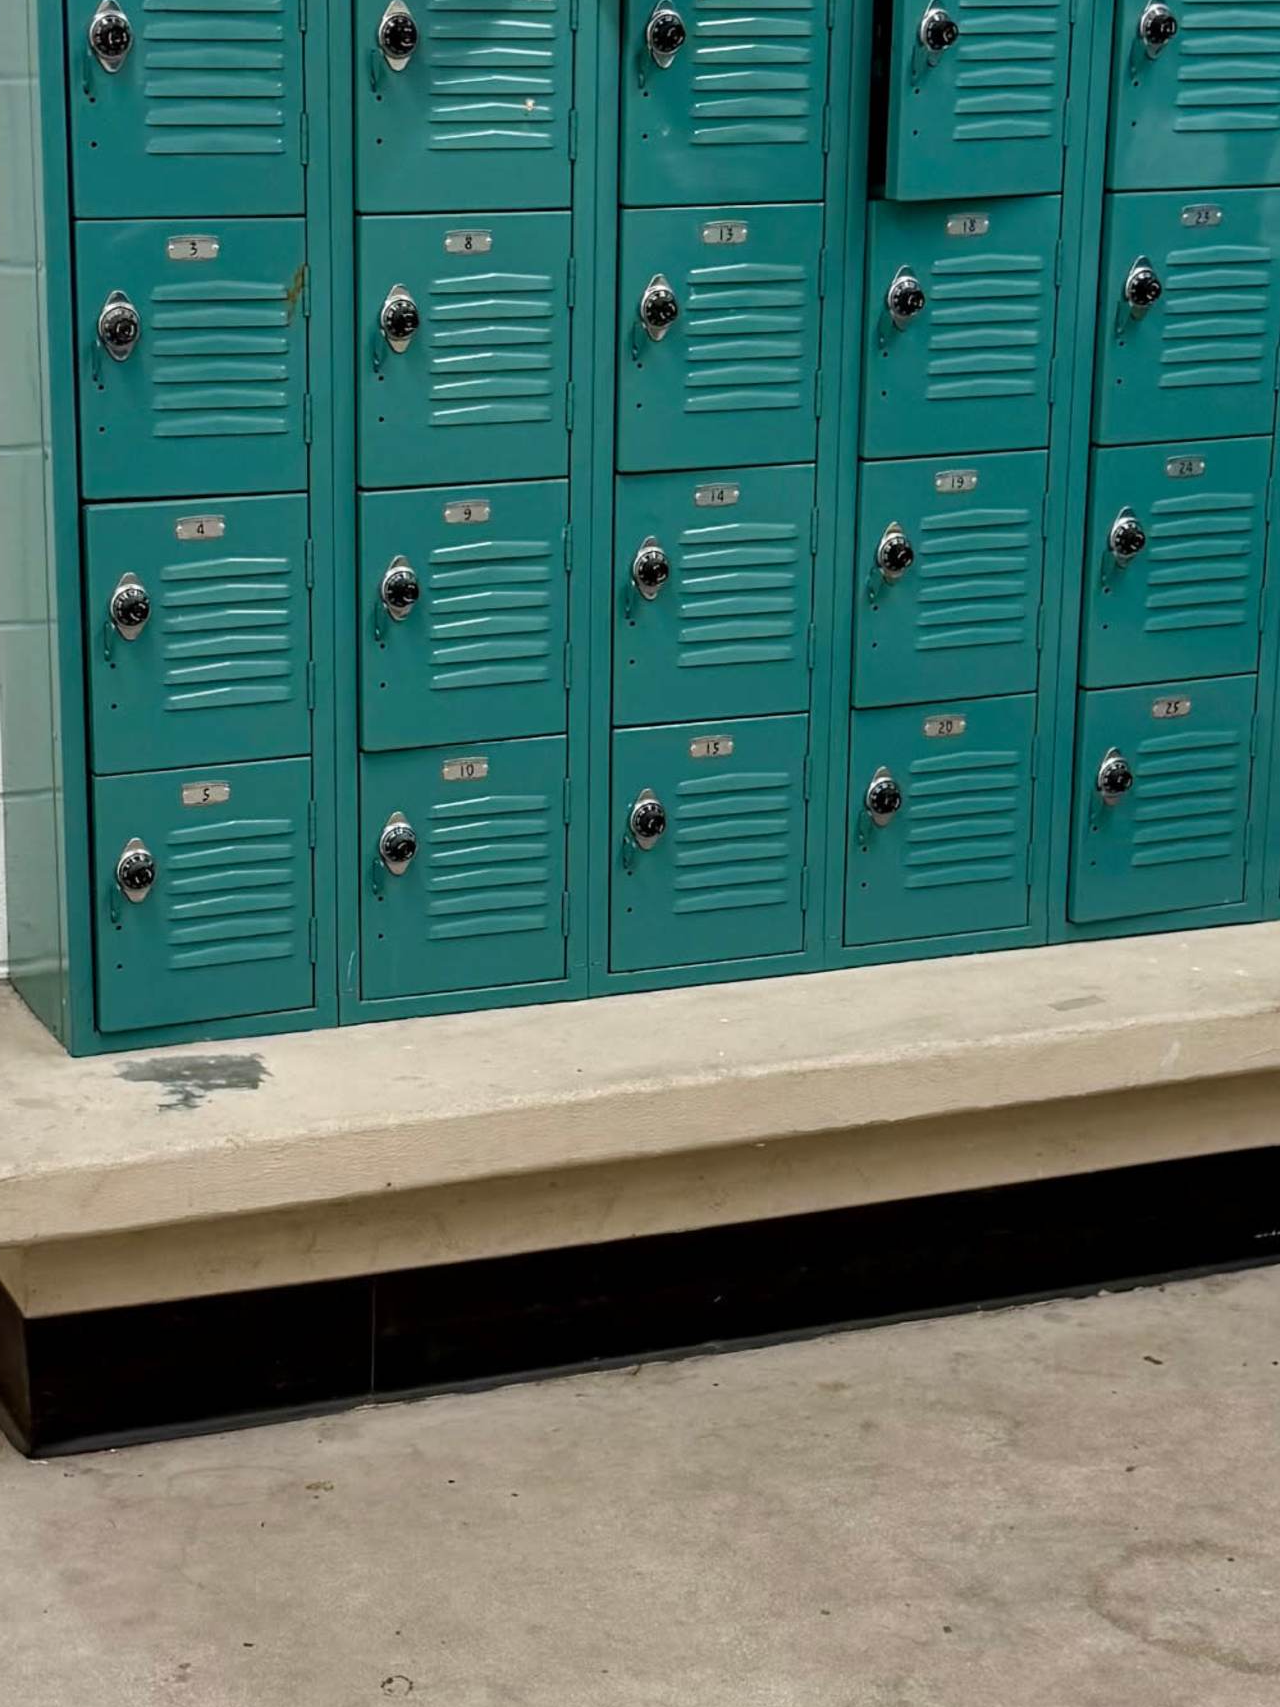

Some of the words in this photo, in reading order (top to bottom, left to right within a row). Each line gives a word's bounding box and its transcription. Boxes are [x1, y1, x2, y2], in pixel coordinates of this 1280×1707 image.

[1196, 211, 1209, 225] 23
[963, 219, 976, 232] 18
[720, 227, 733, 242] 13
[190, 242, 197, 256] 3
[464, 235, 472, 250] 8
[1180, 462, 1193, 474] 24
[951, 476, 964, 488] 19
[711, 490, 724, 502] 14
[464, 507, 472, 520] 9
[197, 523, 204, 534] 4
[1166, 701, 1180, 714] 25
[939, 721, 953, 734] 20
[707, 742, 719, 754] 15
[460, 764, 474, 777] 10
[203, 788, 210, 802] 5
